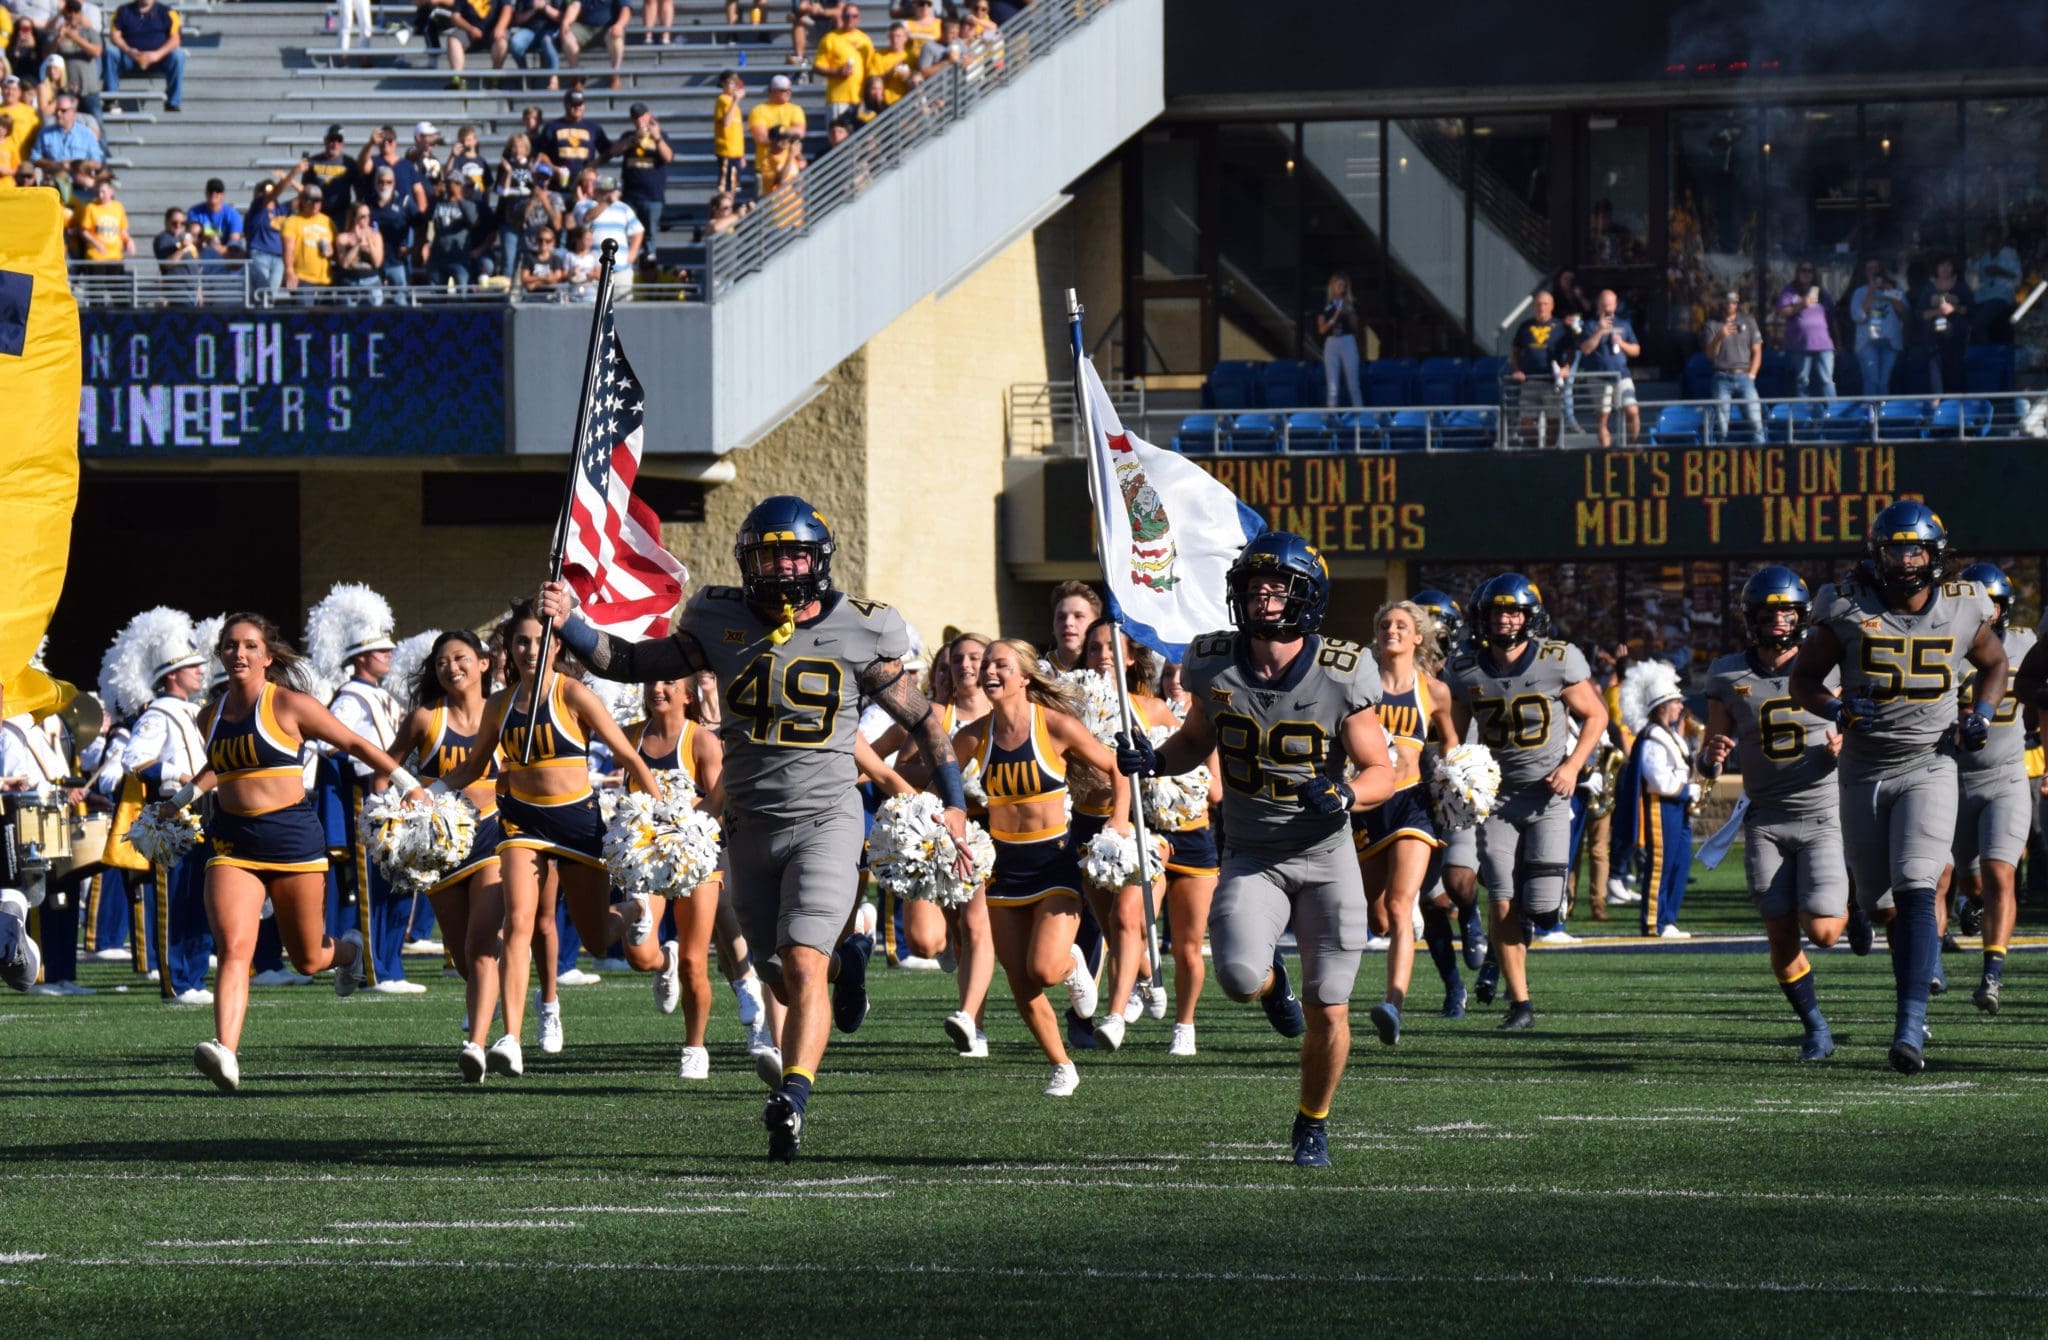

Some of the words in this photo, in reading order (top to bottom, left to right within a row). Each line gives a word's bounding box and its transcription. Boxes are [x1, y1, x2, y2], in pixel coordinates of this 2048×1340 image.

[1196, 458, 1292, 506] RING
[1305, 458, 1347, 505] ON
[1358, 457, 1397, 504] TH
[1584, 451, 1671, 499] LET'S
[1682, 448, 1786, 498] BRING
[1799, 447, 1843, 494] ON
[1855, 446, 1896, 493] TH
[1762, 493, 1925, 544] INEE
[1861, 635, 1956, 702] 55
[726, 652, 845, 746] 49
[1471, 692, 1552, 751] 30
[211, 733, 260, 773] WVU
[1213, 711, 1327, 801] 89
[1758, 695, 1807, 762] 6
[986, 759, 1042, 797] WVU
